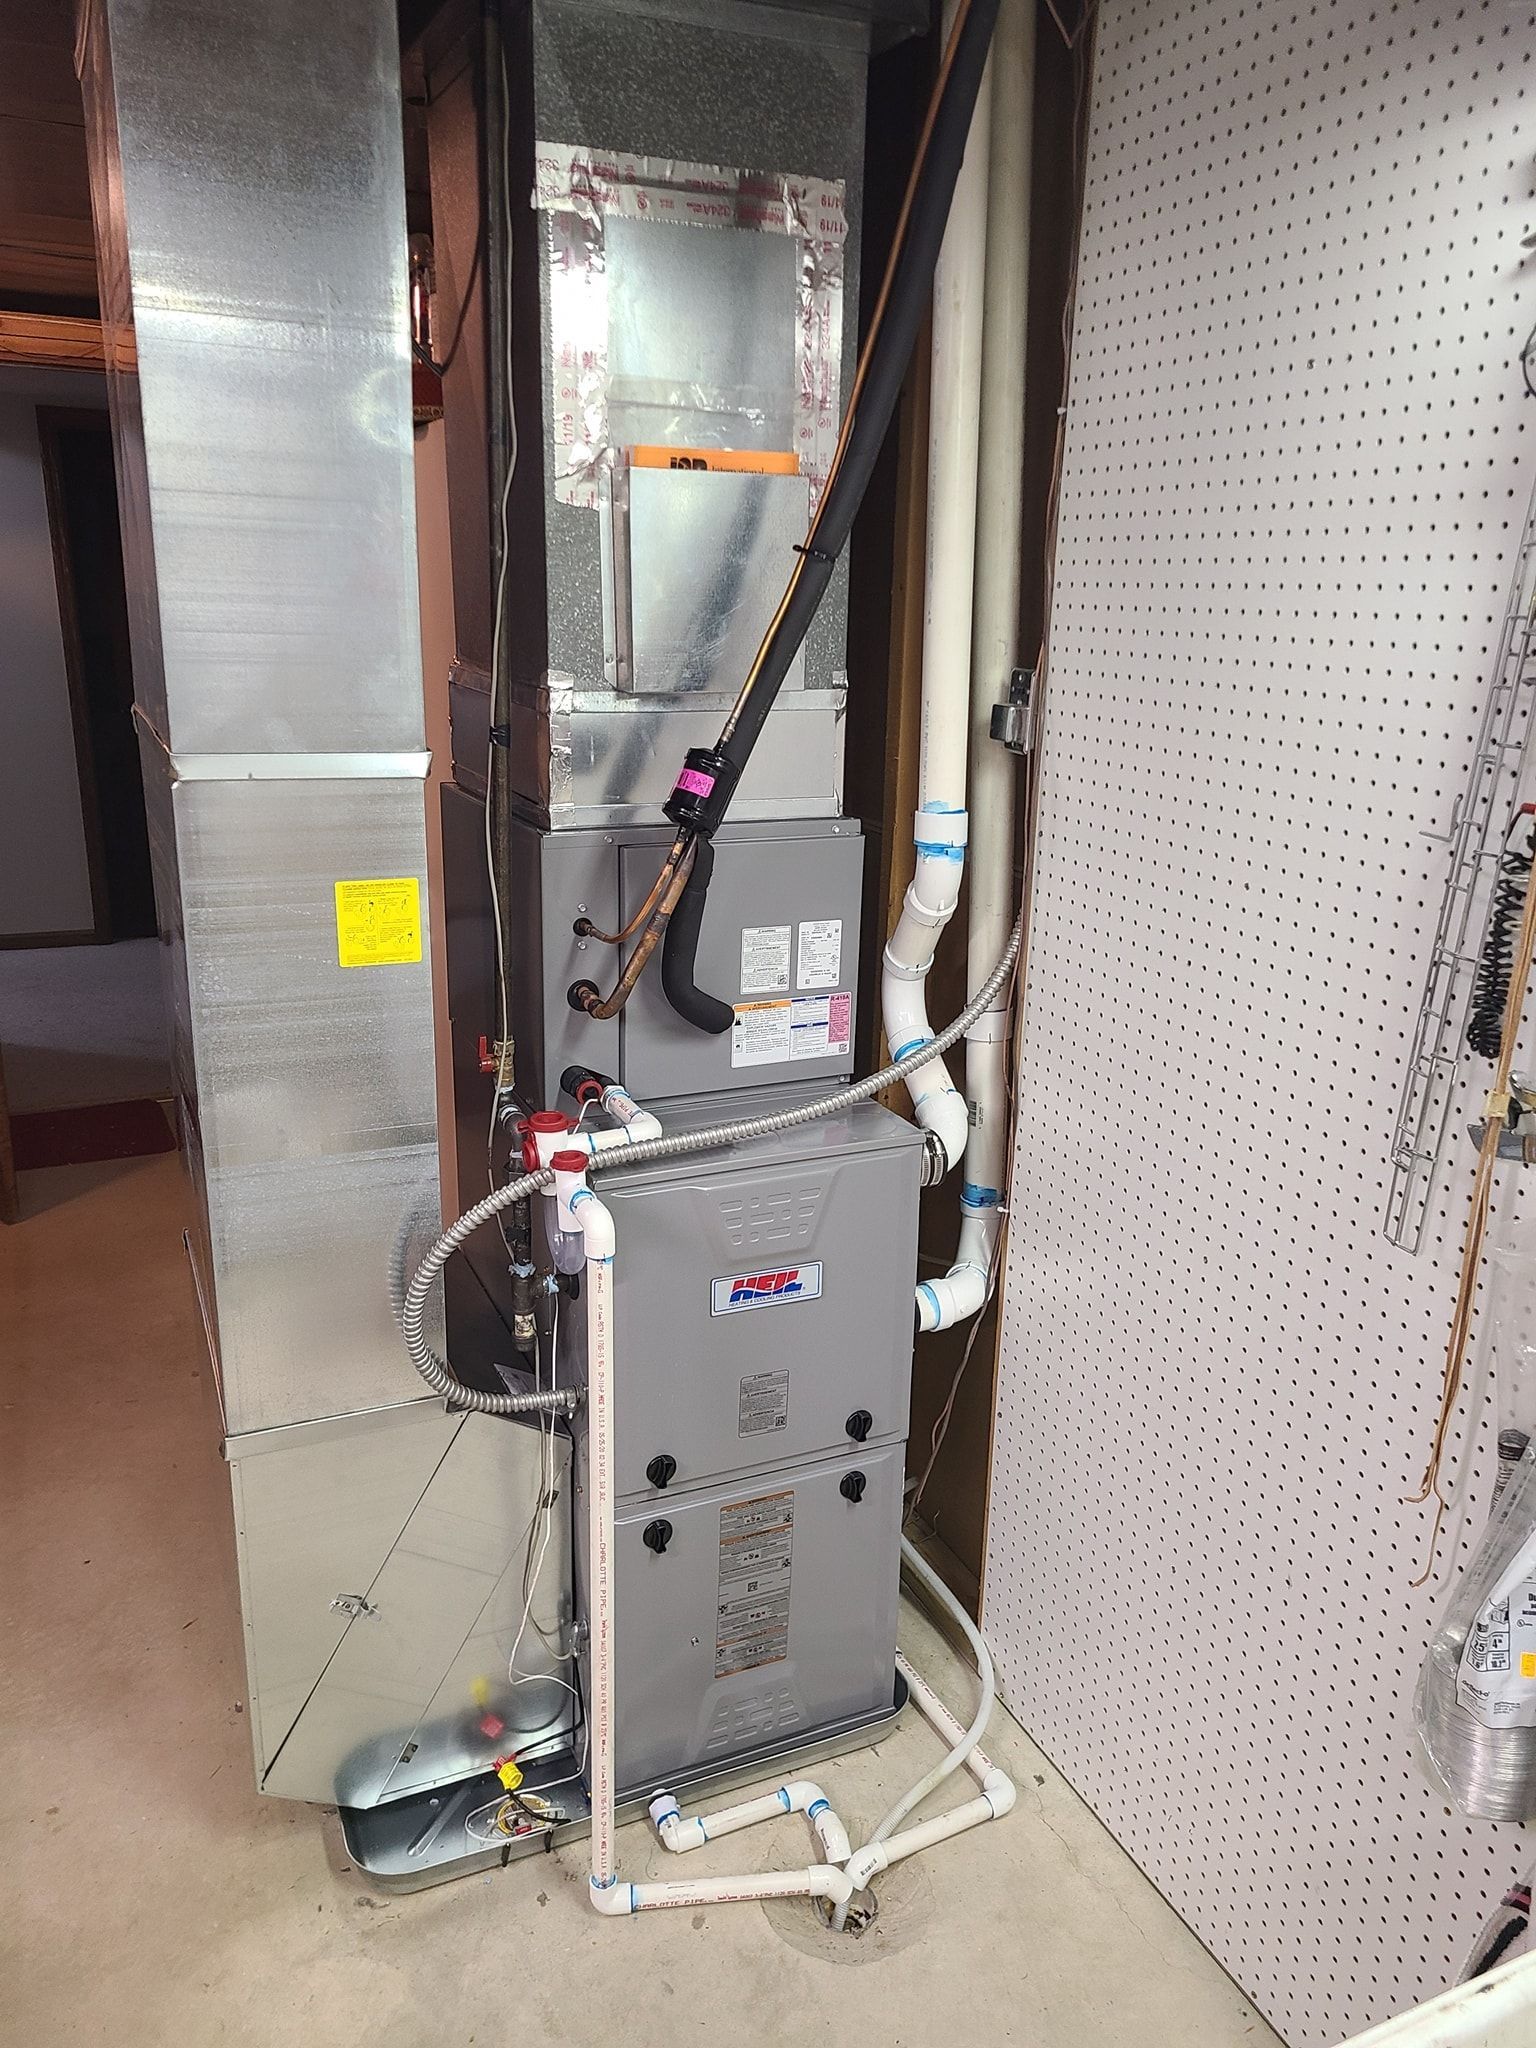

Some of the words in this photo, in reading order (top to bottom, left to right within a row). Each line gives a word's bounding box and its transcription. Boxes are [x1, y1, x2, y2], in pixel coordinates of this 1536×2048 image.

[820, 218, 843, 234] 11/19
[729, 1269, 803, 1303] HEIL
[775, 1291, 801, 1299] PRODUCTS
[599, 1589, 607, 1609] PIPE
